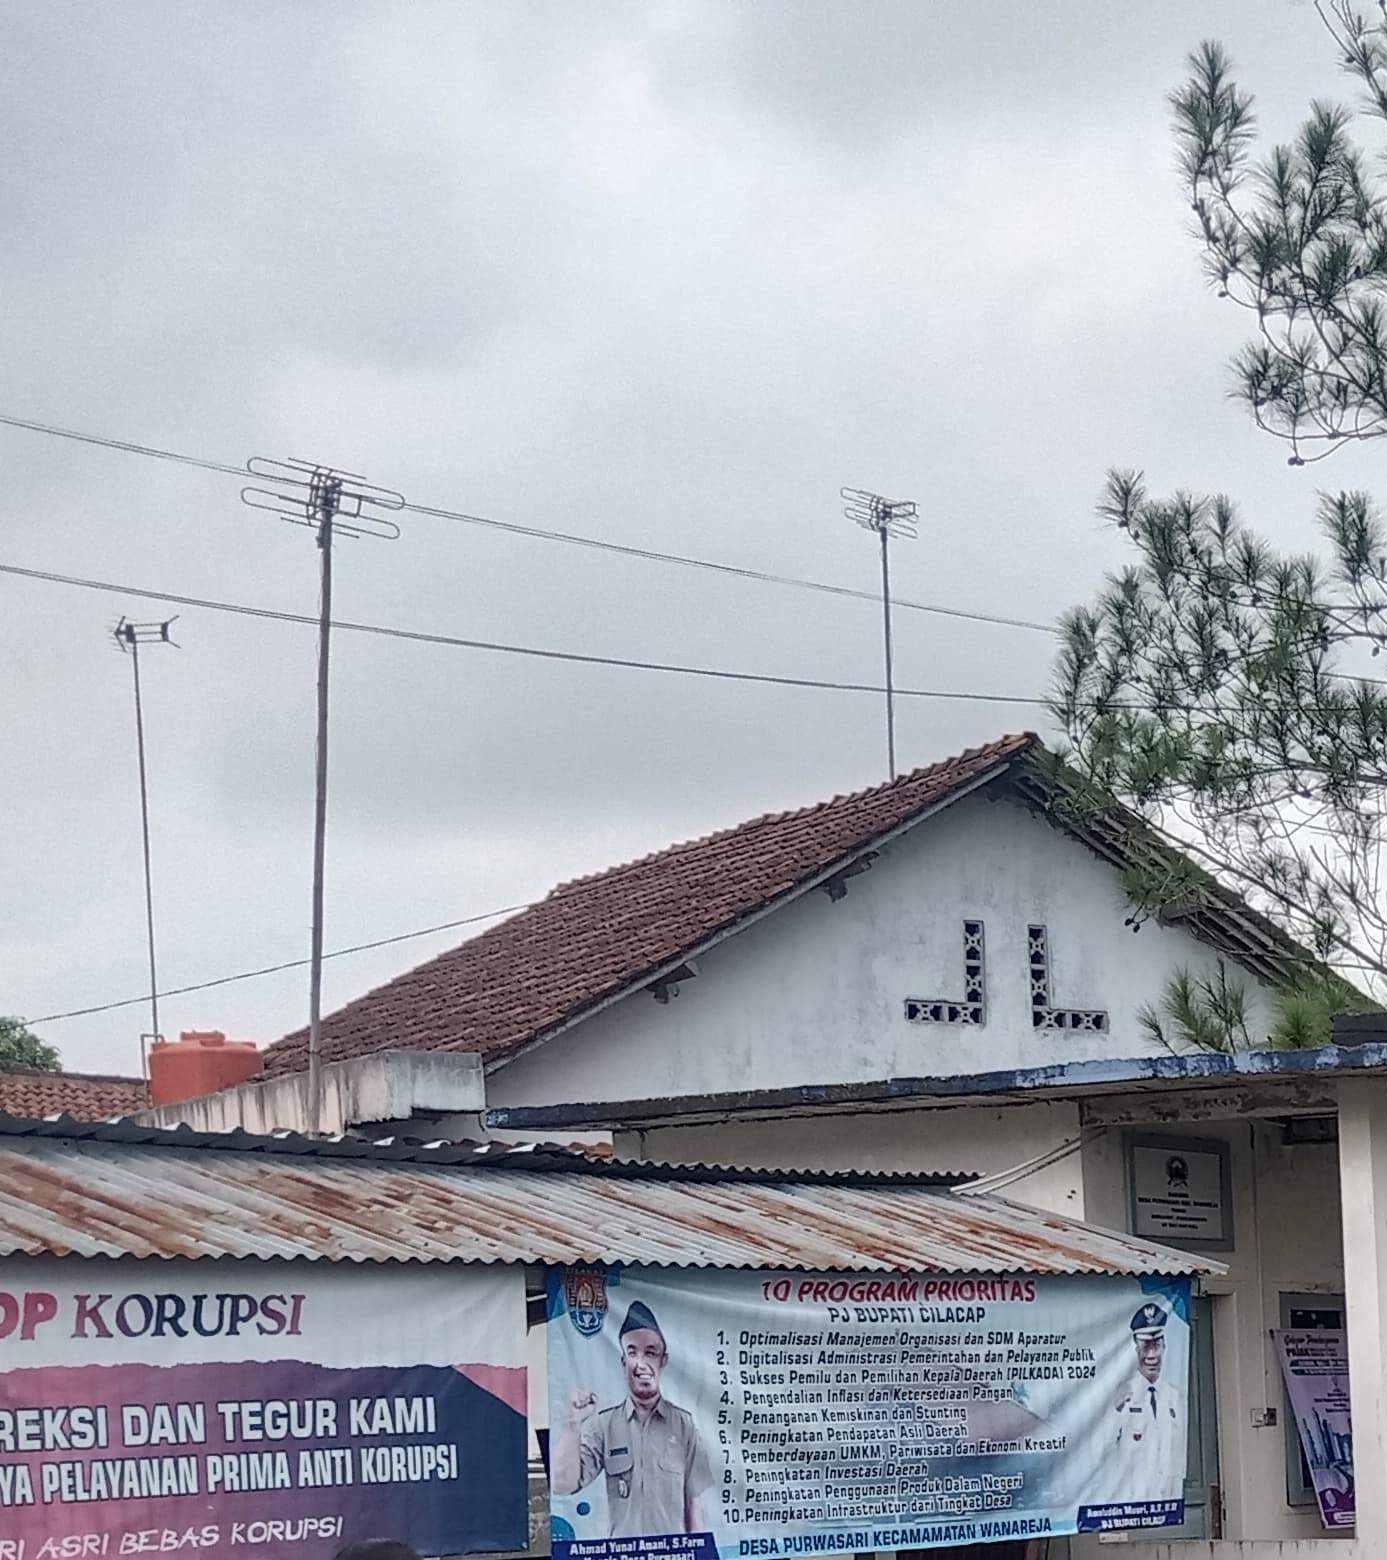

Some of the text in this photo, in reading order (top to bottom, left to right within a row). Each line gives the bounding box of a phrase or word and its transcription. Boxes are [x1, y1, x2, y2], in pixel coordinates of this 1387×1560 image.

[762, 1279, 1036, 1302] 10 PROGRAM PRIORITAS
[70, 1292, 306, 1338] KORUPSI
[828, 1306, 986, 1322] PJ BUPATI CILACAP
[740, 1331, 824, 1348] Optimalisasi
[827, 1332, 896, 1347] Manajemen
[900, 1332, 961, 1348] Organisasi
[964, 1332, 983, 1345] dan
[987, 1331, 1013, 1345] SDM
[1018, 1331, 1066, 1347] Aparatur
[739, 1351, 813, 1368] Digitalisasi
[818, 1350, 897, 1365] Administrasi
[900, 1350, 980, 1364] Pemerintahan
[985, 1350, 1003, 1364] dan
[1006, 1349, 1058, 1365] Pelayanan
[1062, 1348, 1095, 1362] Publik
[740, 1370, 784, 1385] Sukses
[790, 1370, 831, 1384] Pemilu
[835, 1369, 857, 1383] dan
[862, 1369, 919, 1383] Pemilihan
[923, 1368, 960, 1384] Kepala
[964, 1368, 1003, 1381] Daerah
[1067, 1365, 1096, 1379] 2024
[744, 1389, 822, 1408] Pengendalian
[827, 1388, 864, 1403] Inflasi
[868, 1388, 888, 1402] dan
[893, 1387, 968, 1402] Ketersediaan
[973, 1386, 1013, 1401] Pangan
[121, 1402, 206, 1448] DAN
[217, 1399, 338, 1443] TEGUR
[349, 1395, 438, 1437] KAMI
[742, 1410, 818, 1427] Penanganan
[821, 1408, 889, 1423] Kemiskinan
[892, 1406, 912, 1420] dan
[916, 1405, 967, 1421] Stunting
[740, 1429, 823, 1446] Peningkatan
[827, 1427, 896, 1443] Pendapatan
[900, 1424, 923, 1438] Asli
[926, 1423, 968, 1437] Daerah
[742, 1448, 836, 1464] Pemberdayaan
[840, 1445, 886, 1461] UMKM,
[890, 1443, 952, 1459] Pariwisata
[956, 1442, 975, 1455] dan
[979, 1440, 1021, 1454] Ekonomi
[1025, 1436, 1066, 1450] Kreatif
[42, 1454, 200, 1503] PELAYANAN
[207, 1450, 292, 1493] PRIMA
[298, 1448, 354, 1488] ANTI
[360, 1443, 459, 1484] KORUPSI
[746, 1467, 820, 1485] Peningkatan
[825, 1464, 882, 1480] Investasi
[886, 1461, 928, 1477] Daerah
[746, 1487, 821, 1505] Peningkatan
[825, 1482, 897, 1501] Penggunaan
[901, 1478, 943, 1494] Produk
[945, 1475, 980, 1490] Dalam
[984, 1472, 1024, 1490] Negeri
[827, 1501, 908, 1518] Infrastruktur
[911, 1498, 935, 1513] dari
[938, 1496, 981, 1513] Tingkat
[985, 1494, 1012, 1507] Desa
[36, 1532, 110, 1560] ASRI
[119, 1524, 220, 1556] BEBAS
[231, 1516, 344, 1546] KORUPSI
[739, 1517, 1052, 1556] DESA PURWASARI KECAMAMATAN WANAREJA
[569, 1541, 607, 1556] Ahmad
